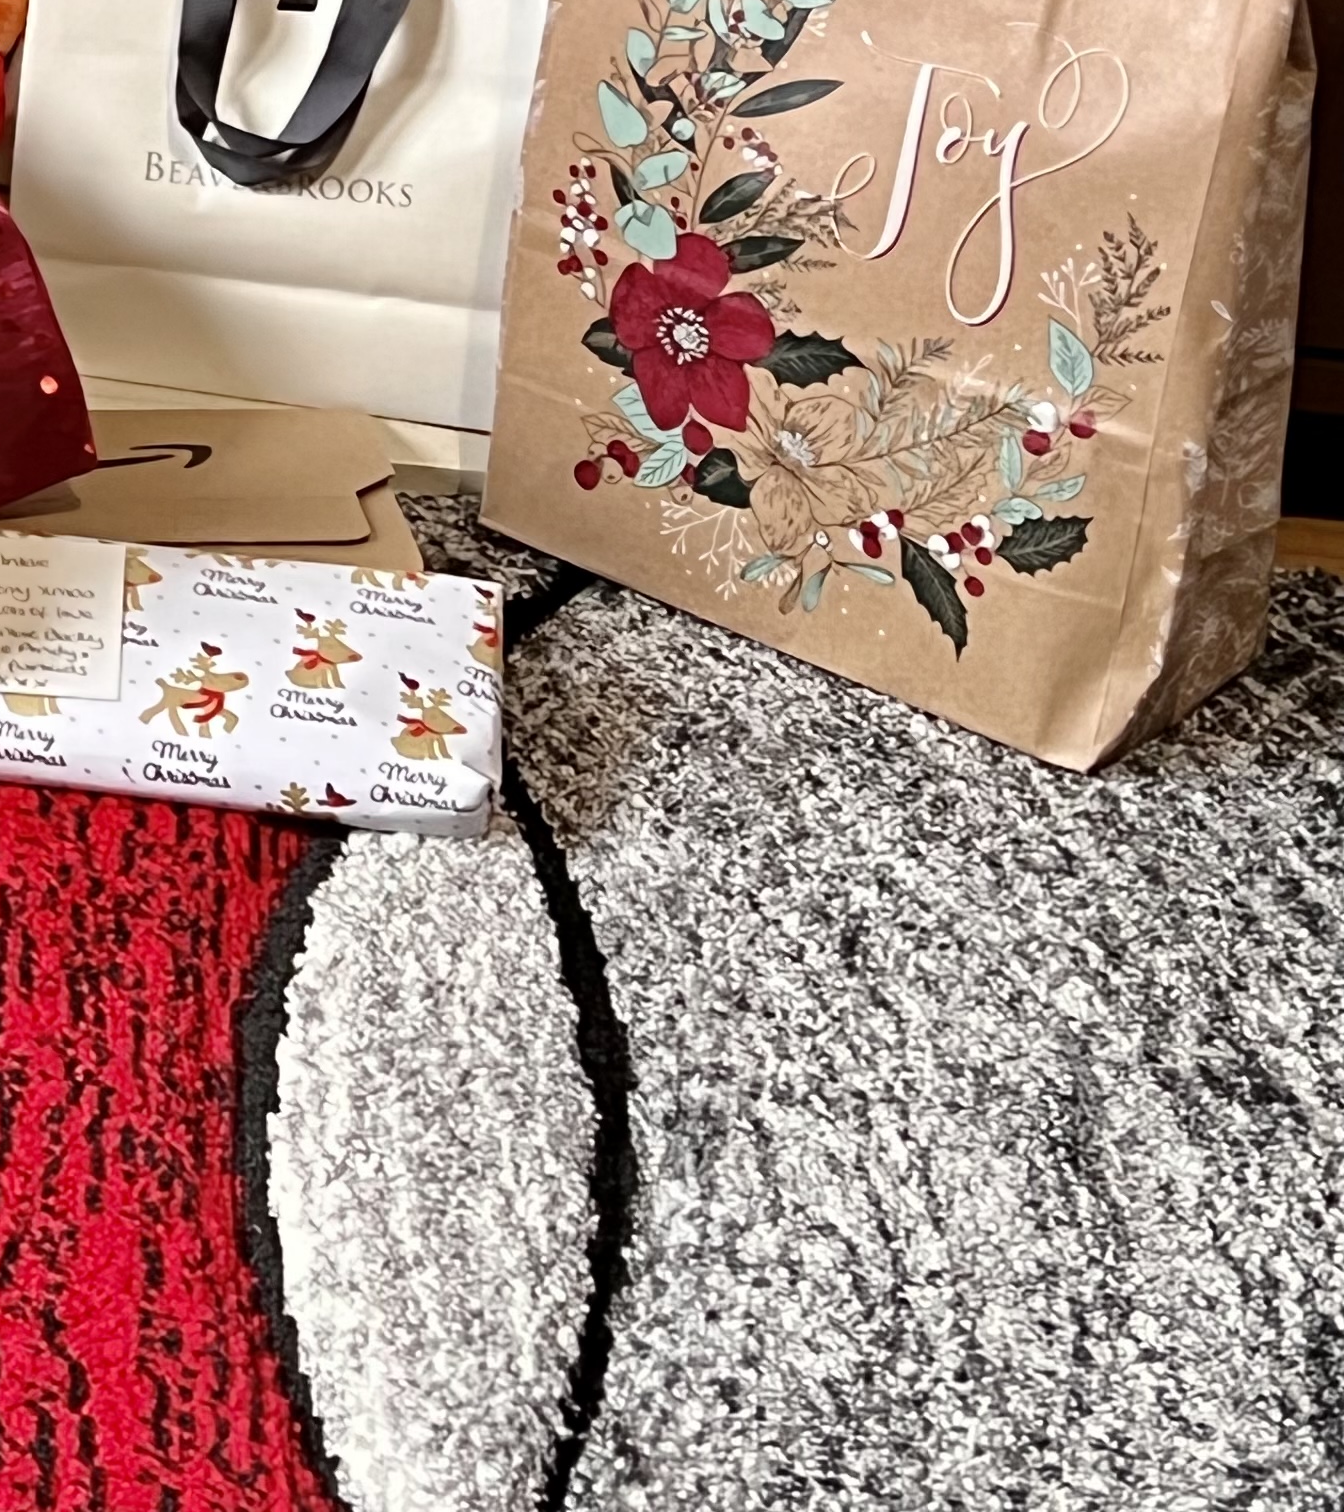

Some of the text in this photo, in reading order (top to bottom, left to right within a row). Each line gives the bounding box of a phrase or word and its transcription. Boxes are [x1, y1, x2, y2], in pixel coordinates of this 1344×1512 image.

[357, 588, 423, 613] Merry
[277, 688, 345, 714] Merry
[151, 740, 219, 773] Merry
[378, 761, 448, 796] Merry
